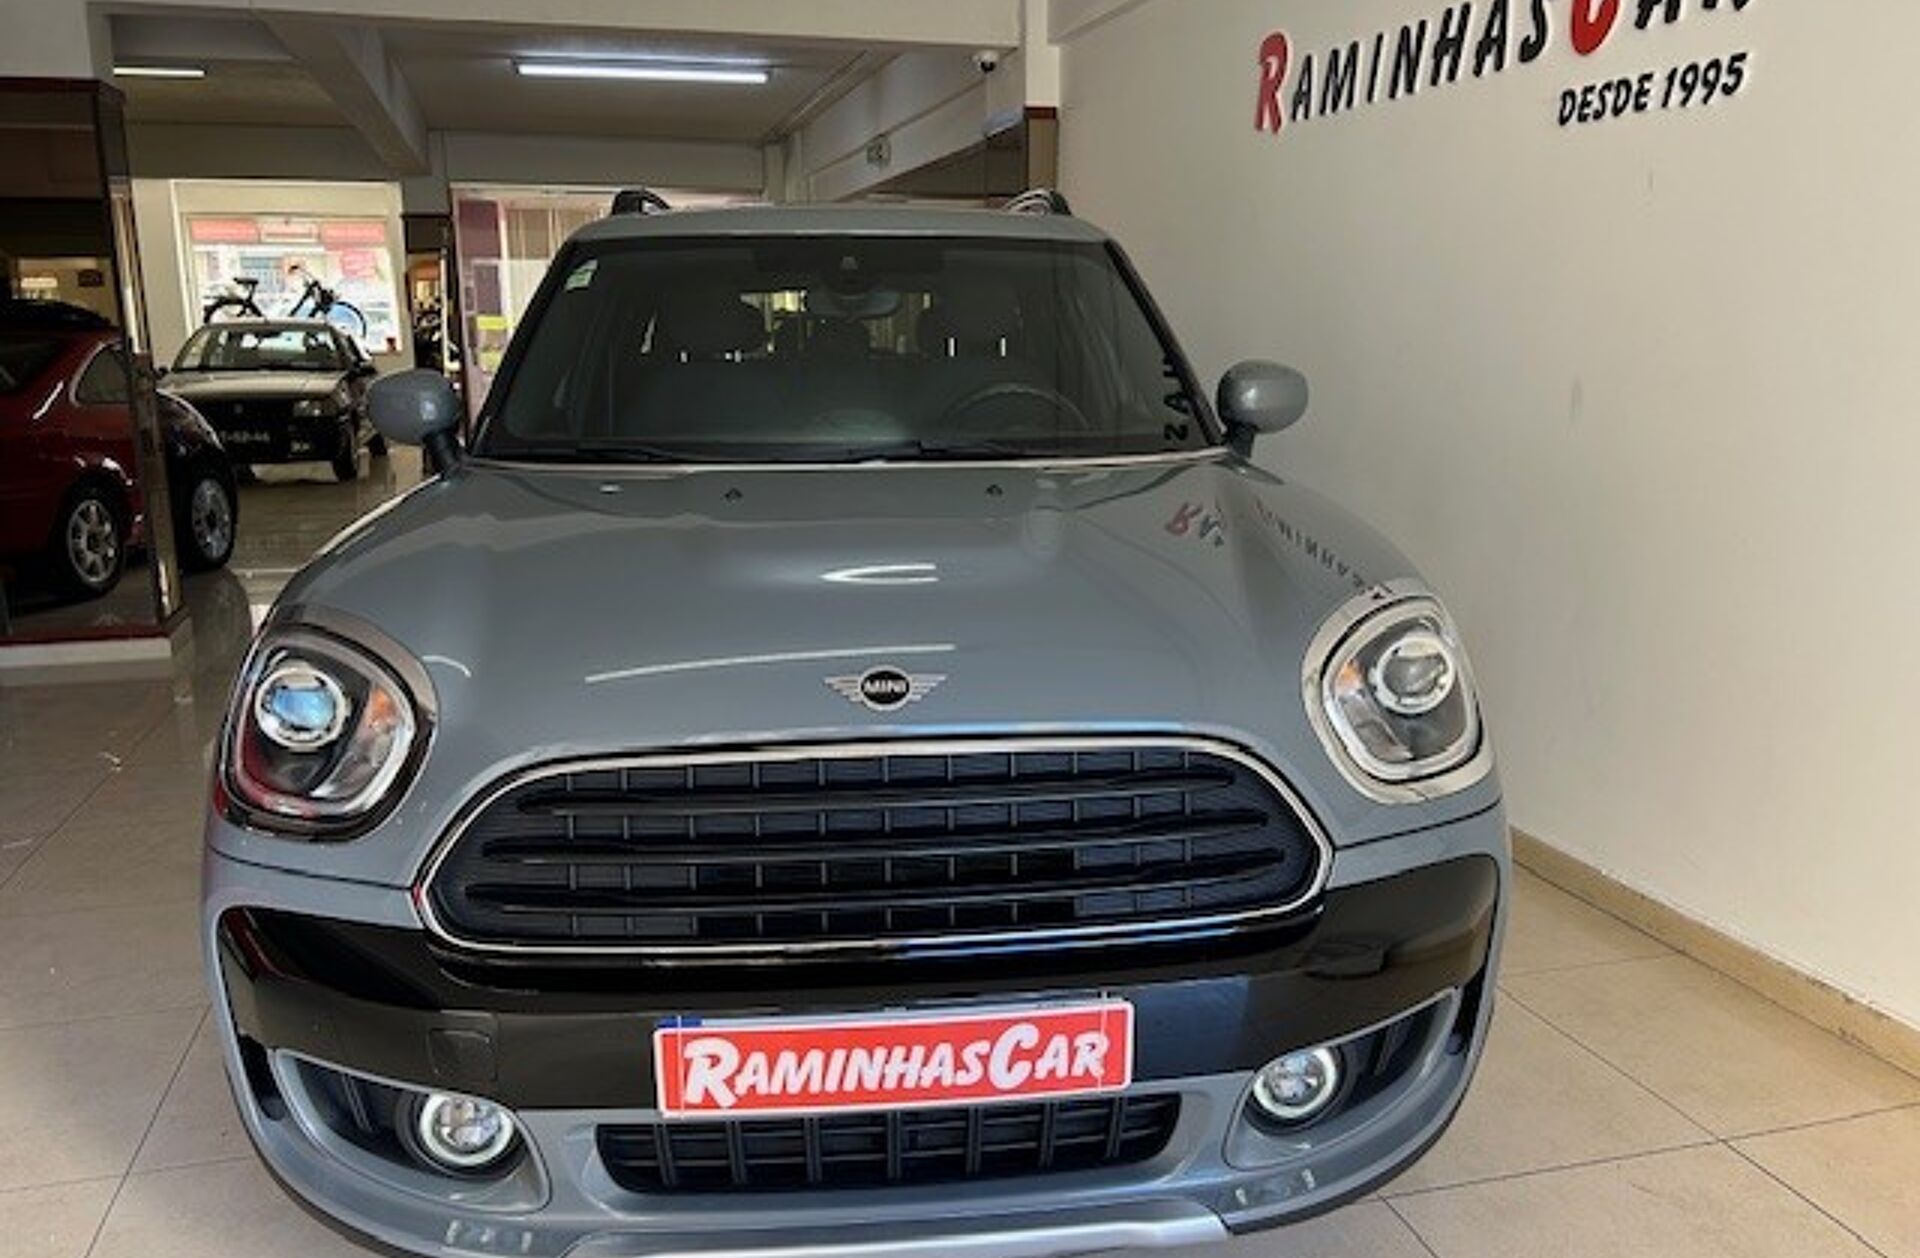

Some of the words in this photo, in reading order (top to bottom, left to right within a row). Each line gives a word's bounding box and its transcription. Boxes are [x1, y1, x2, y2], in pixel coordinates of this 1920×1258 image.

[1255, 0, 1751, 134] RAMINHAS
[1558, 72, 1654, 126] DESDE
[1661, 52, 1747, 108] 1995
[862, 679, 907, 693] MINI
